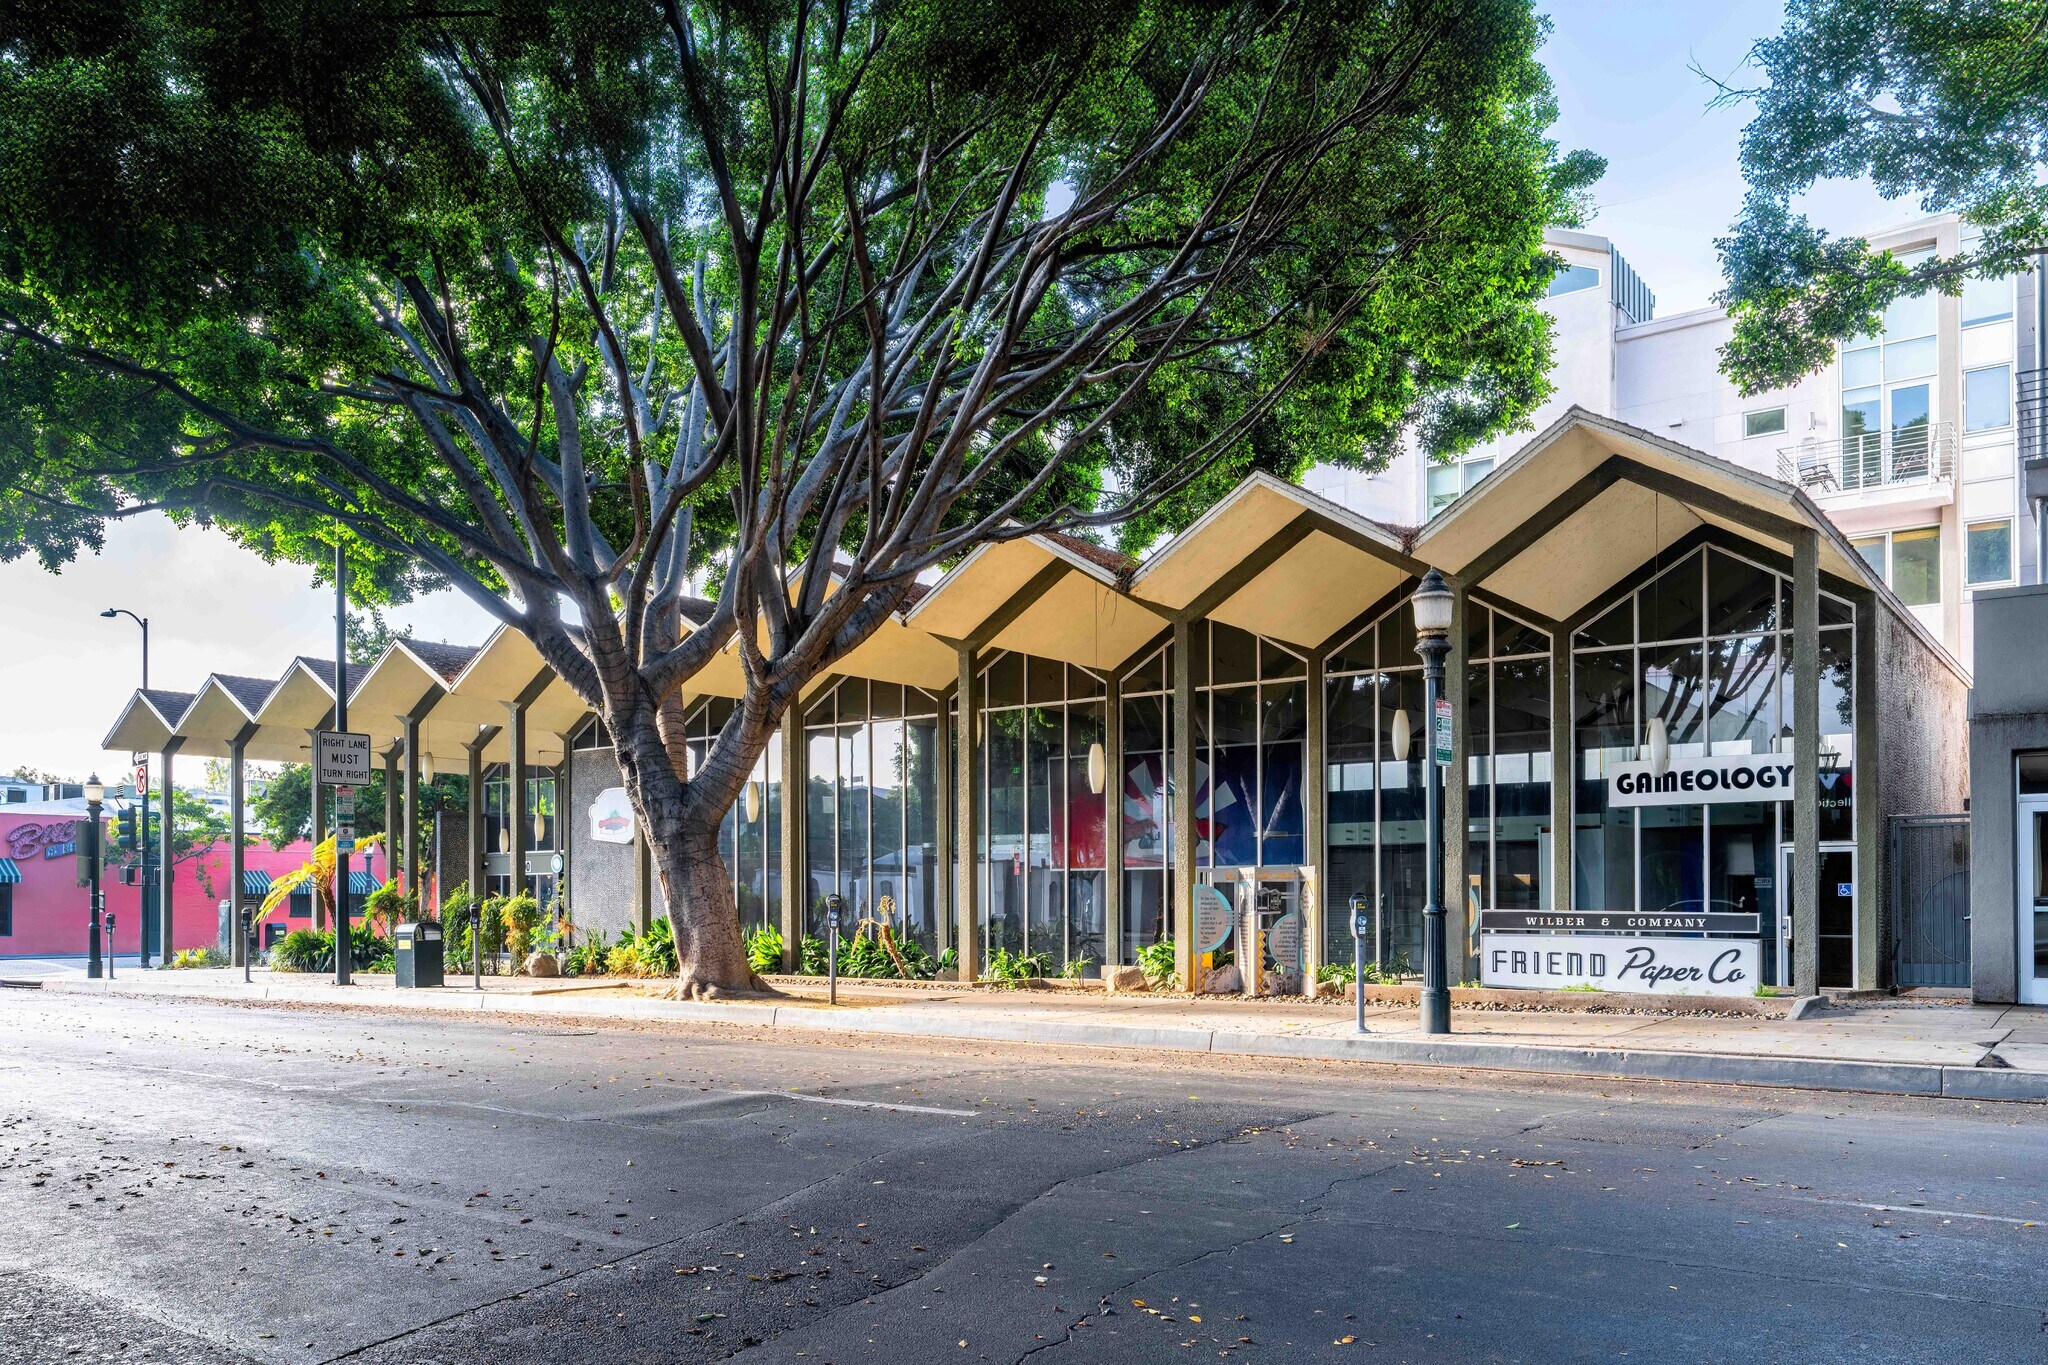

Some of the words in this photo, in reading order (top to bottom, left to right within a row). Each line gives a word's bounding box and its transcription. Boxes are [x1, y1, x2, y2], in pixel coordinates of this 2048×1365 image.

[323, 738, 345, 747] RIGHT
[349, 740, 367, 749] LANE
[331, 753, 359, 764] MUST
[323, 768, 343, 778] TURN
[346, 770, 368, 779] RIGHT
[1616, 764, 1794, 795] GAMEOLOGY
[1526, 917, 1585, 926] WILBER
[1601, 917, 1610, 926] &
[1627, 918, 1706, 927] COMPANY
[1492, 949, 1606, 977] FRIEND
[1617, 946, 1703, 988] Paper
[1708, 948, 1745, 984] Co
